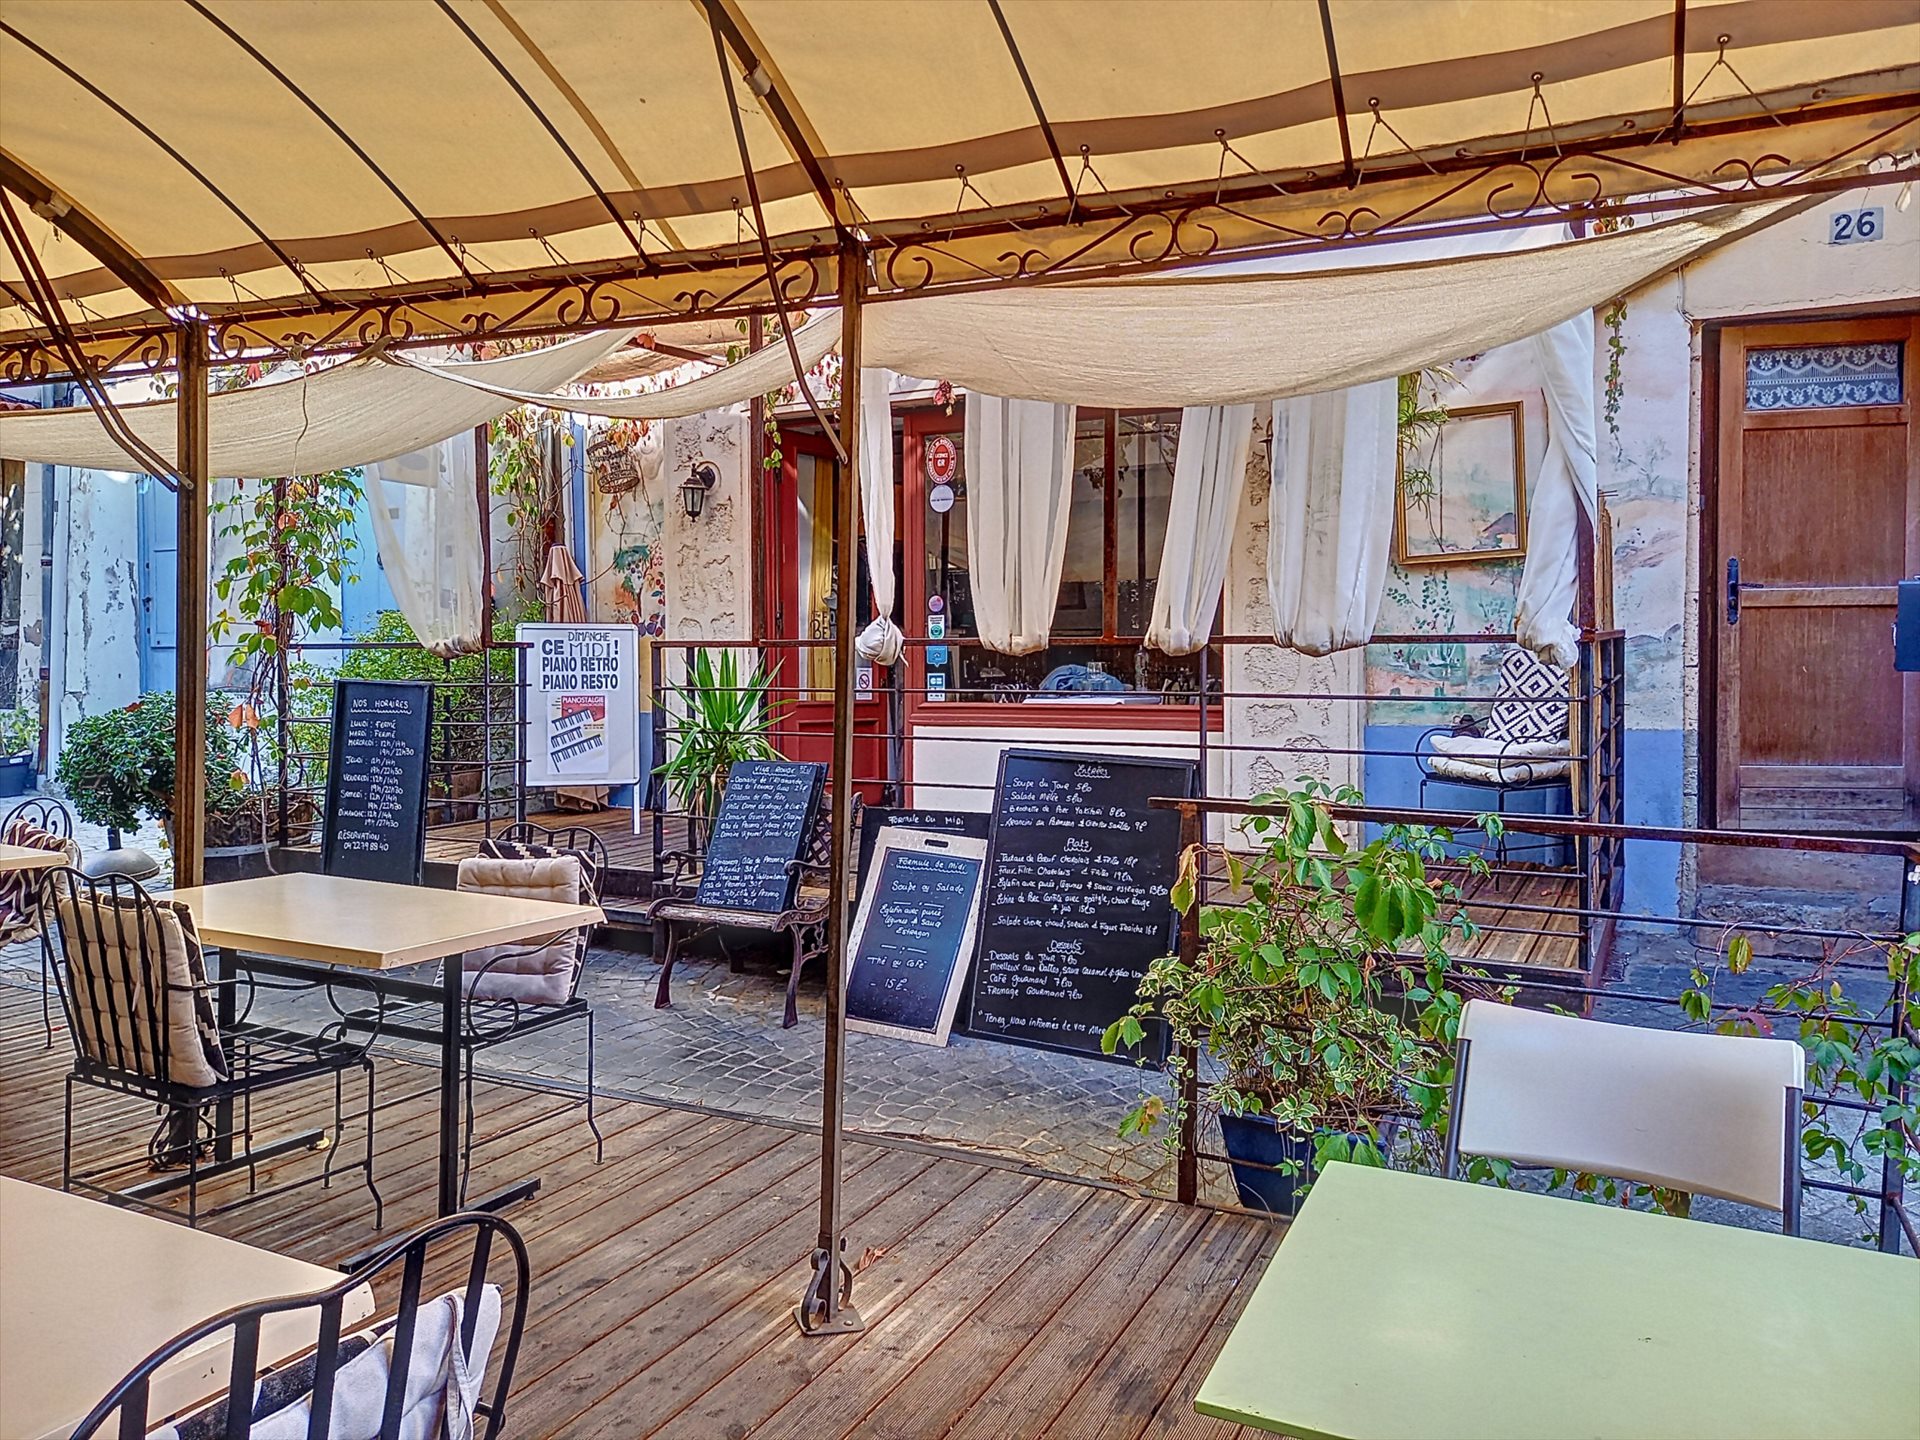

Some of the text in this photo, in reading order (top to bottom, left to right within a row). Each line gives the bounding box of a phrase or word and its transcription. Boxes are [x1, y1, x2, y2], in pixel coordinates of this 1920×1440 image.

[1834, 211, 1875, 241] 26
[568, 631, 610, 642] DIMANCHE
[542, 639, 565, 656] CE
[542, 657, 619, 672] PIANO RETRO
[542, 674, 618, 690] PIANO RESTO
[353, 699, 368, 708] NOS
[562, 696, 604, 704] PIANOSTALGIE
[1012, 777, 1035, 791] Soupe
[1039, 777, 1049, 788] du
[1010, 791, 1036, 801] Salade
[1042, 804, 1050, 813] de
[1066, 837, 1090, 849] Plats
[1026, 853, 1034, 863] de
[891, 880, 917, 893] Soupe
[1017, 892, 1026, 903] de
[997, 915, 1021, 927] Salade
[1024, 950, 1035, 961] du
[989, 973, 1007, 984] Café
[987, 985, 1066, 1000] Fromage Gourmand
[1062, 1019, 1072, 1032] de
